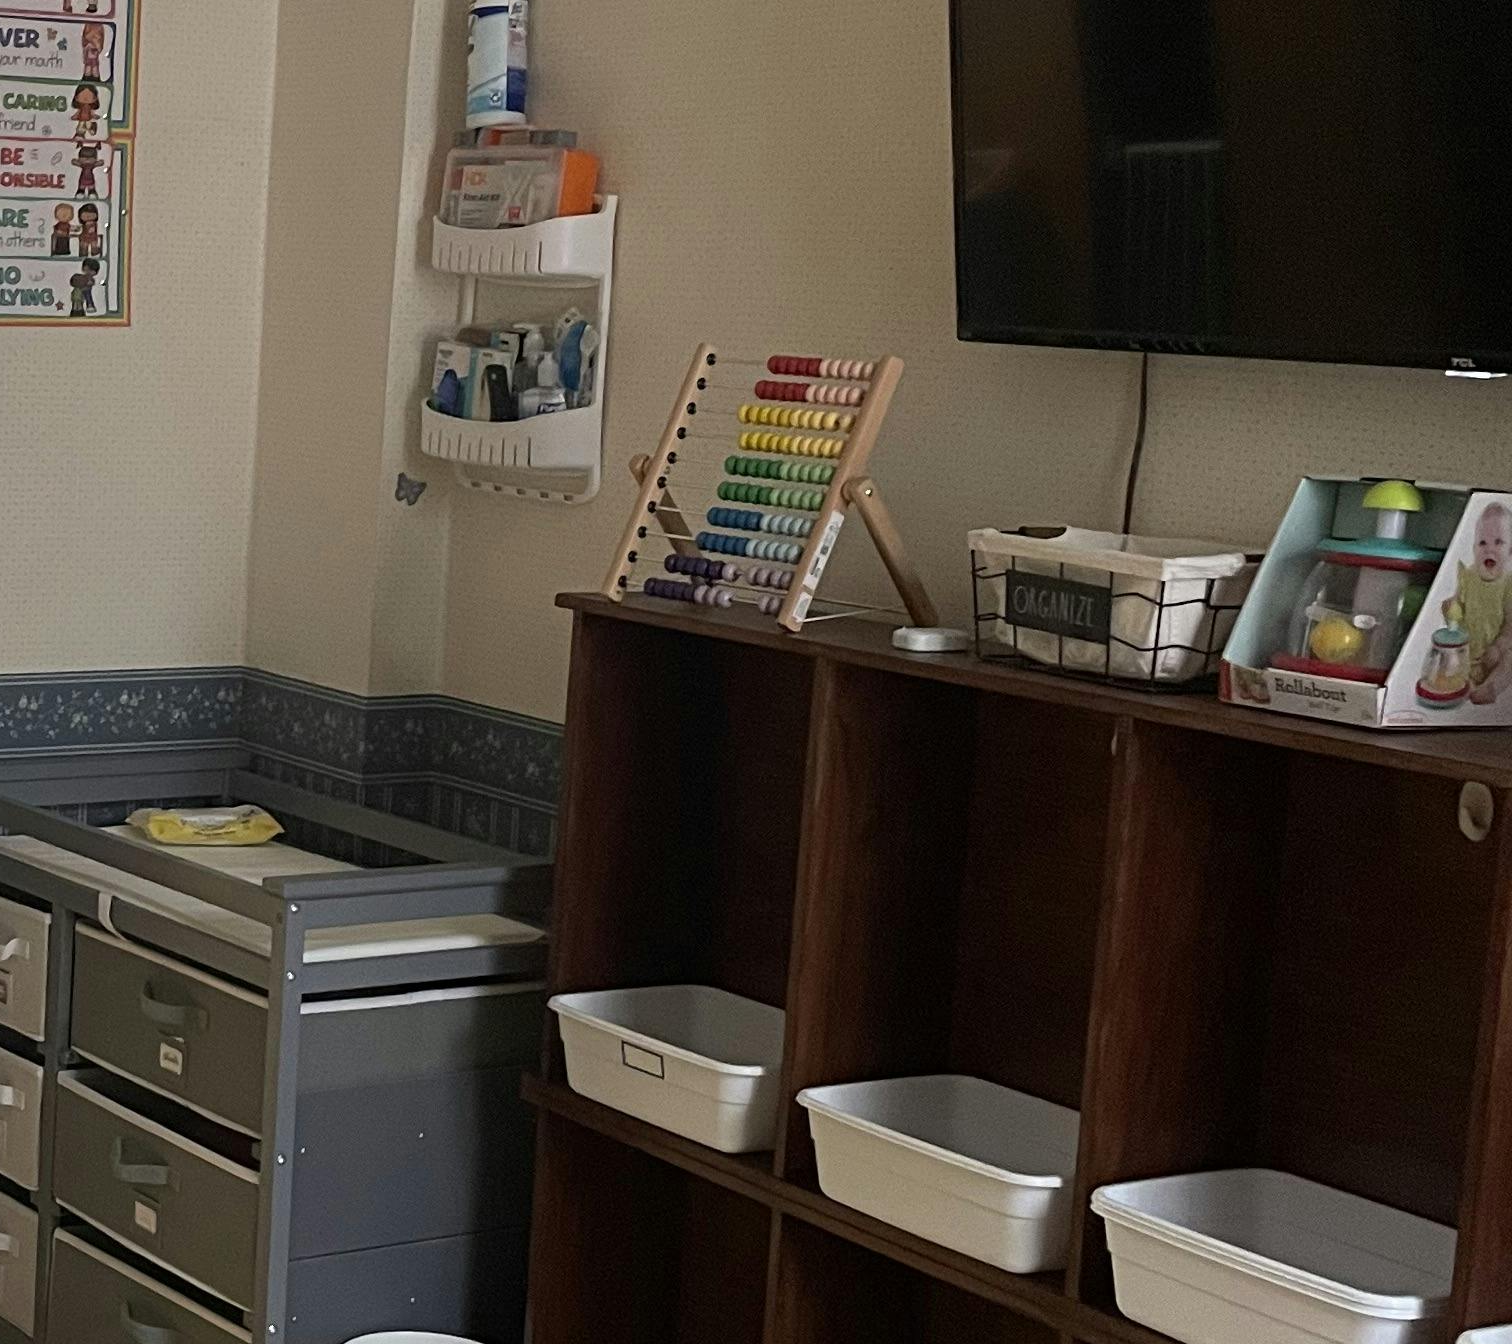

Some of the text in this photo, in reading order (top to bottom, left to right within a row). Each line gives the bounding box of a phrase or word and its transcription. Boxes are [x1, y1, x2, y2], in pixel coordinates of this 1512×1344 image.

[25, 51, 63, 69] mouth
[3, 92, 68, 112] CARING
[0, 147, 25, 166] BE
[5, 233, 45, 249] others
[1451, 357, 1476, 368] TCL
[1013, 585, 1096, 628] ORGANIZE
[1274, 676, 1348, 704] Rollabout
